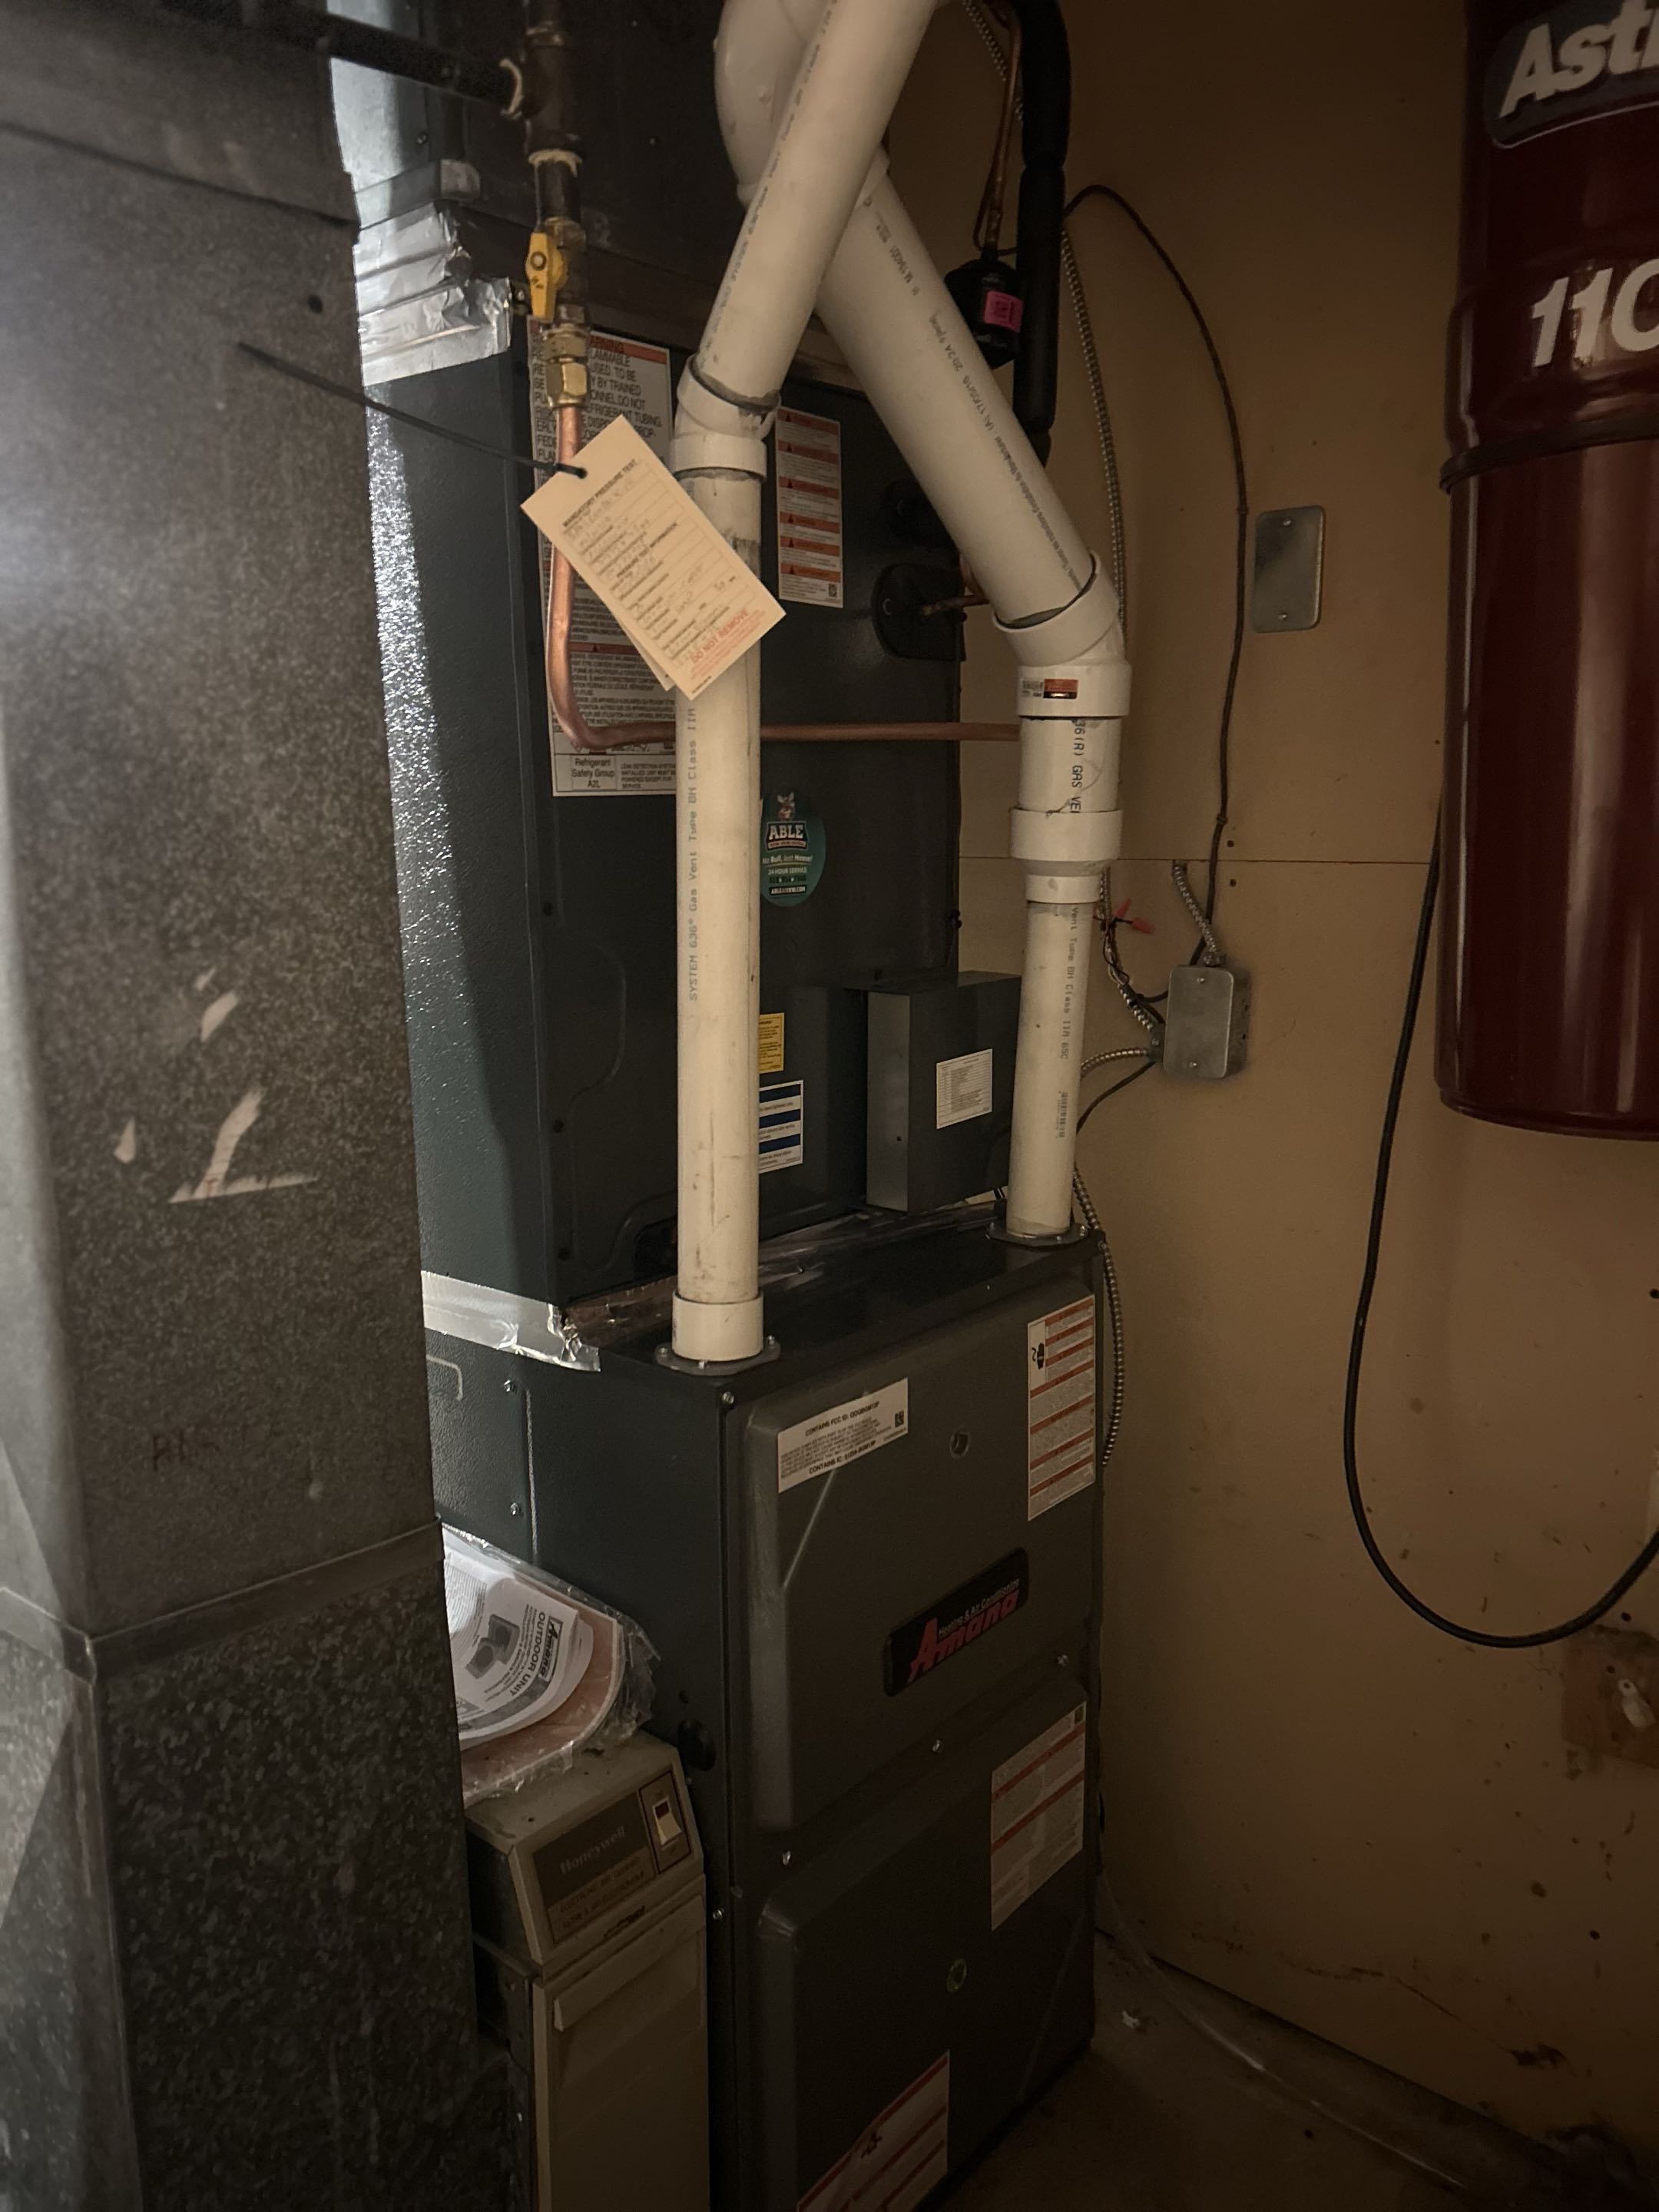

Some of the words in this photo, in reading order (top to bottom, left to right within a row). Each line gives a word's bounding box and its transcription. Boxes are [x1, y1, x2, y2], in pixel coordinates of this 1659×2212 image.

[561, 495, 596, 528] MANDATORY
[594, 471, 624, 499] PRESSURE
[621, 458, 637, 474] TEST
[690, 648, 706, 664] DO
[701, 635, 720, 653] NOT
[717, 608, 750, 638] REMOVE
[571, 769, 592, 777] Safety
[595, 769, 614, 777] Group
[575, 757, 610, 767] Refrigerant
[1071, 765, 1083, 789] GAS
[768, 824, 804, 840] ABLE
[688, 955, 697, 1000] SYSTEM
[1064, 984, 1073, 1013] Class
[939, 1616, 964, 1637] Heating
[982, 1578, 1020, 1609] Conditioning
[528, 1611, 545, 1671] OUTDOOR
[541, 1621, 558, 1676] Amana
[906, 1588, 1020, 1684] Amana
[510, 1674, 531, 1696] UNIT
[559, 1825, 626, 1874] Honeywell
